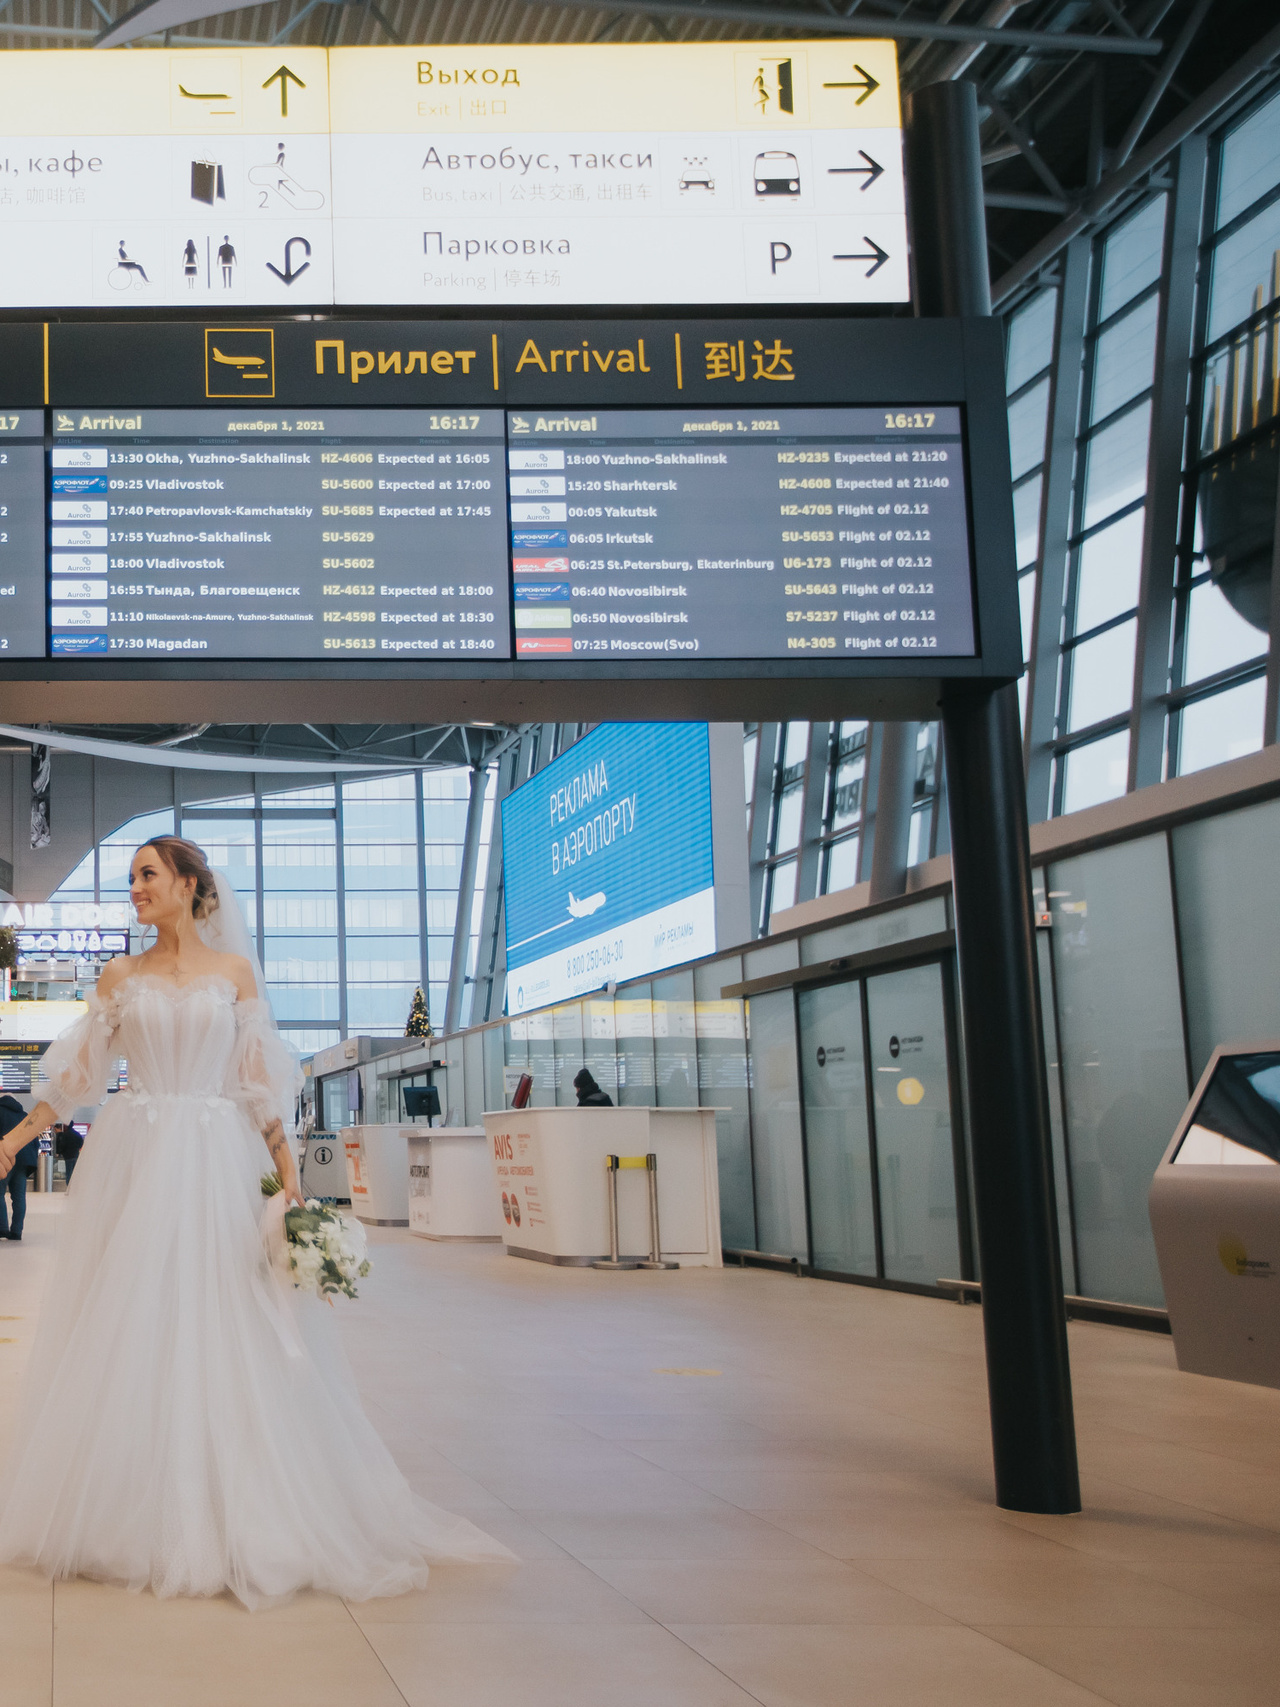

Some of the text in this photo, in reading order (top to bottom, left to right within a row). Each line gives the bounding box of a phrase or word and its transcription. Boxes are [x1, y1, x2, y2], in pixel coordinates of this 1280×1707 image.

[417, 61, 520, 87] Выход
[416, 100, 451, 116] Exit
[470, 99, 507, 116] 出口
[29, 150, 102, 178] кафе
[423, 147, 652, 175] Автобус, такси
[259, 191, 269, 208] 2
[422, 187, 494, 204] Bus, taxi
[424, 232, 570, 261] Парковка
[771, 242, 791, 274] P
[422, 272, 487, 291] Parking
[504, 269, 561, 288] 停车场
[316, 340, 476, 383] Прилет
[516, 339, 650, 372] Arrival
[705, 340, 795, 381] 到达
[80, 416, 141, 429] Arrival
[228, 421, 324, 432] декабря 1, 2021
[430, 416, 479, 429] 16:17
[535, 417, 596, 431] Arrival
[683, 421, 780, 432] декабря 1, 2021
[885, 414, 935, 428] 16:17
[111, 453, 490, 465] 13:30 Okha, Yuzhno-Sakhalinsk HZ-4606 Expected at 16:05
[110, 585, 493, 597] 16:55 Тында, Благовещенск HZ-4612 Expected at 18:00
[574, 637, 936, 651] 07:25 Moscow(Svo) N4-305 Flight of 02.12
[550, 759, 608, 827] РЕКЛАМА
[551, 793, 636, 875] В АЭРОПОРТУ
[2, 903, 125, 927] AIR DOG
[653, 922, 694, 948] МИР РЕКЛАМЫ
[566, 939, 624, 978] 8 800 250-06-30
[494, 1134, 513, 1160] AVIS
